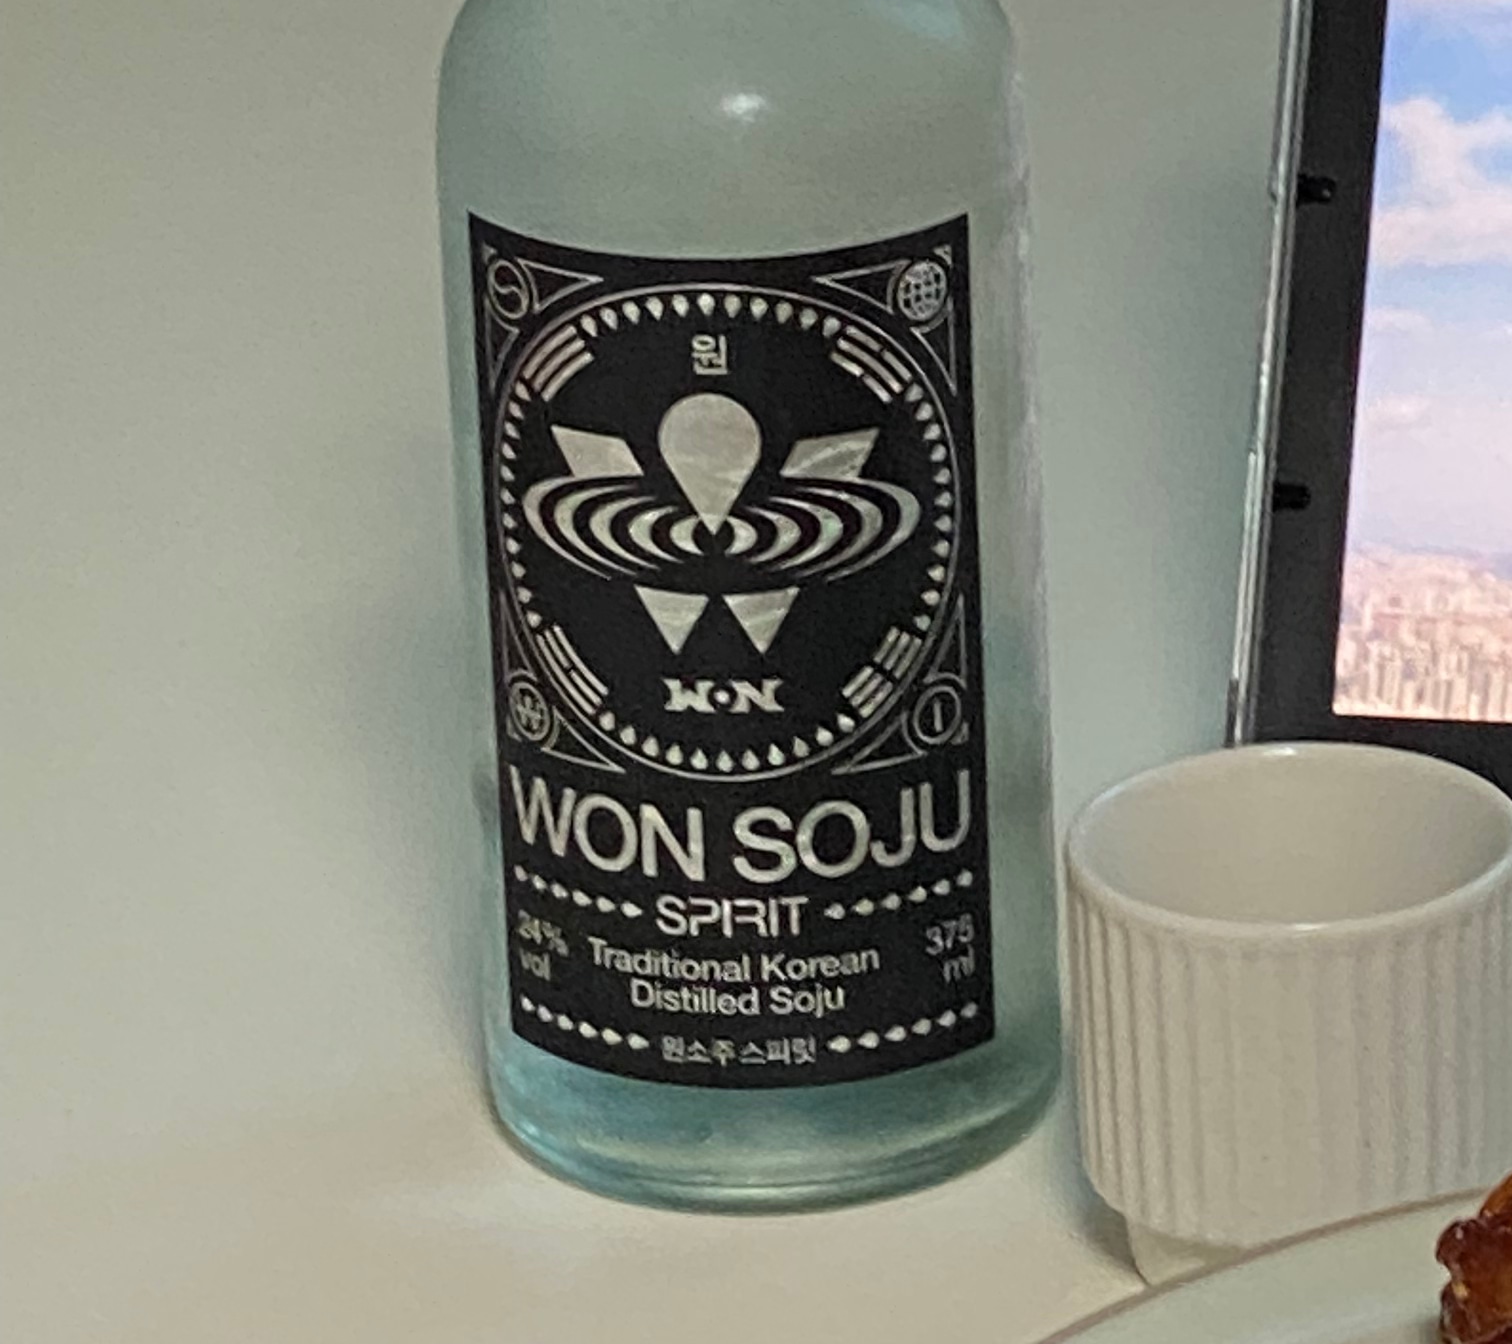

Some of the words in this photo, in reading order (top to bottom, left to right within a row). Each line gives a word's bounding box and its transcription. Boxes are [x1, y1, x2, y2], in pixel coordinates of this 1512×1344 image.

[691, 334, 728, 375] 원
[510, 765, 706, 882] WON
[733, 769, 972, 884] SOJU
[656, 895, 808, 937] SPIRIT
[588, 937, 750, 983] Traditional
[761, 948, 880, 985] Korean
[631, 978, 760, 1015] Distilled
[769, 979, 845, 1018] Soju
